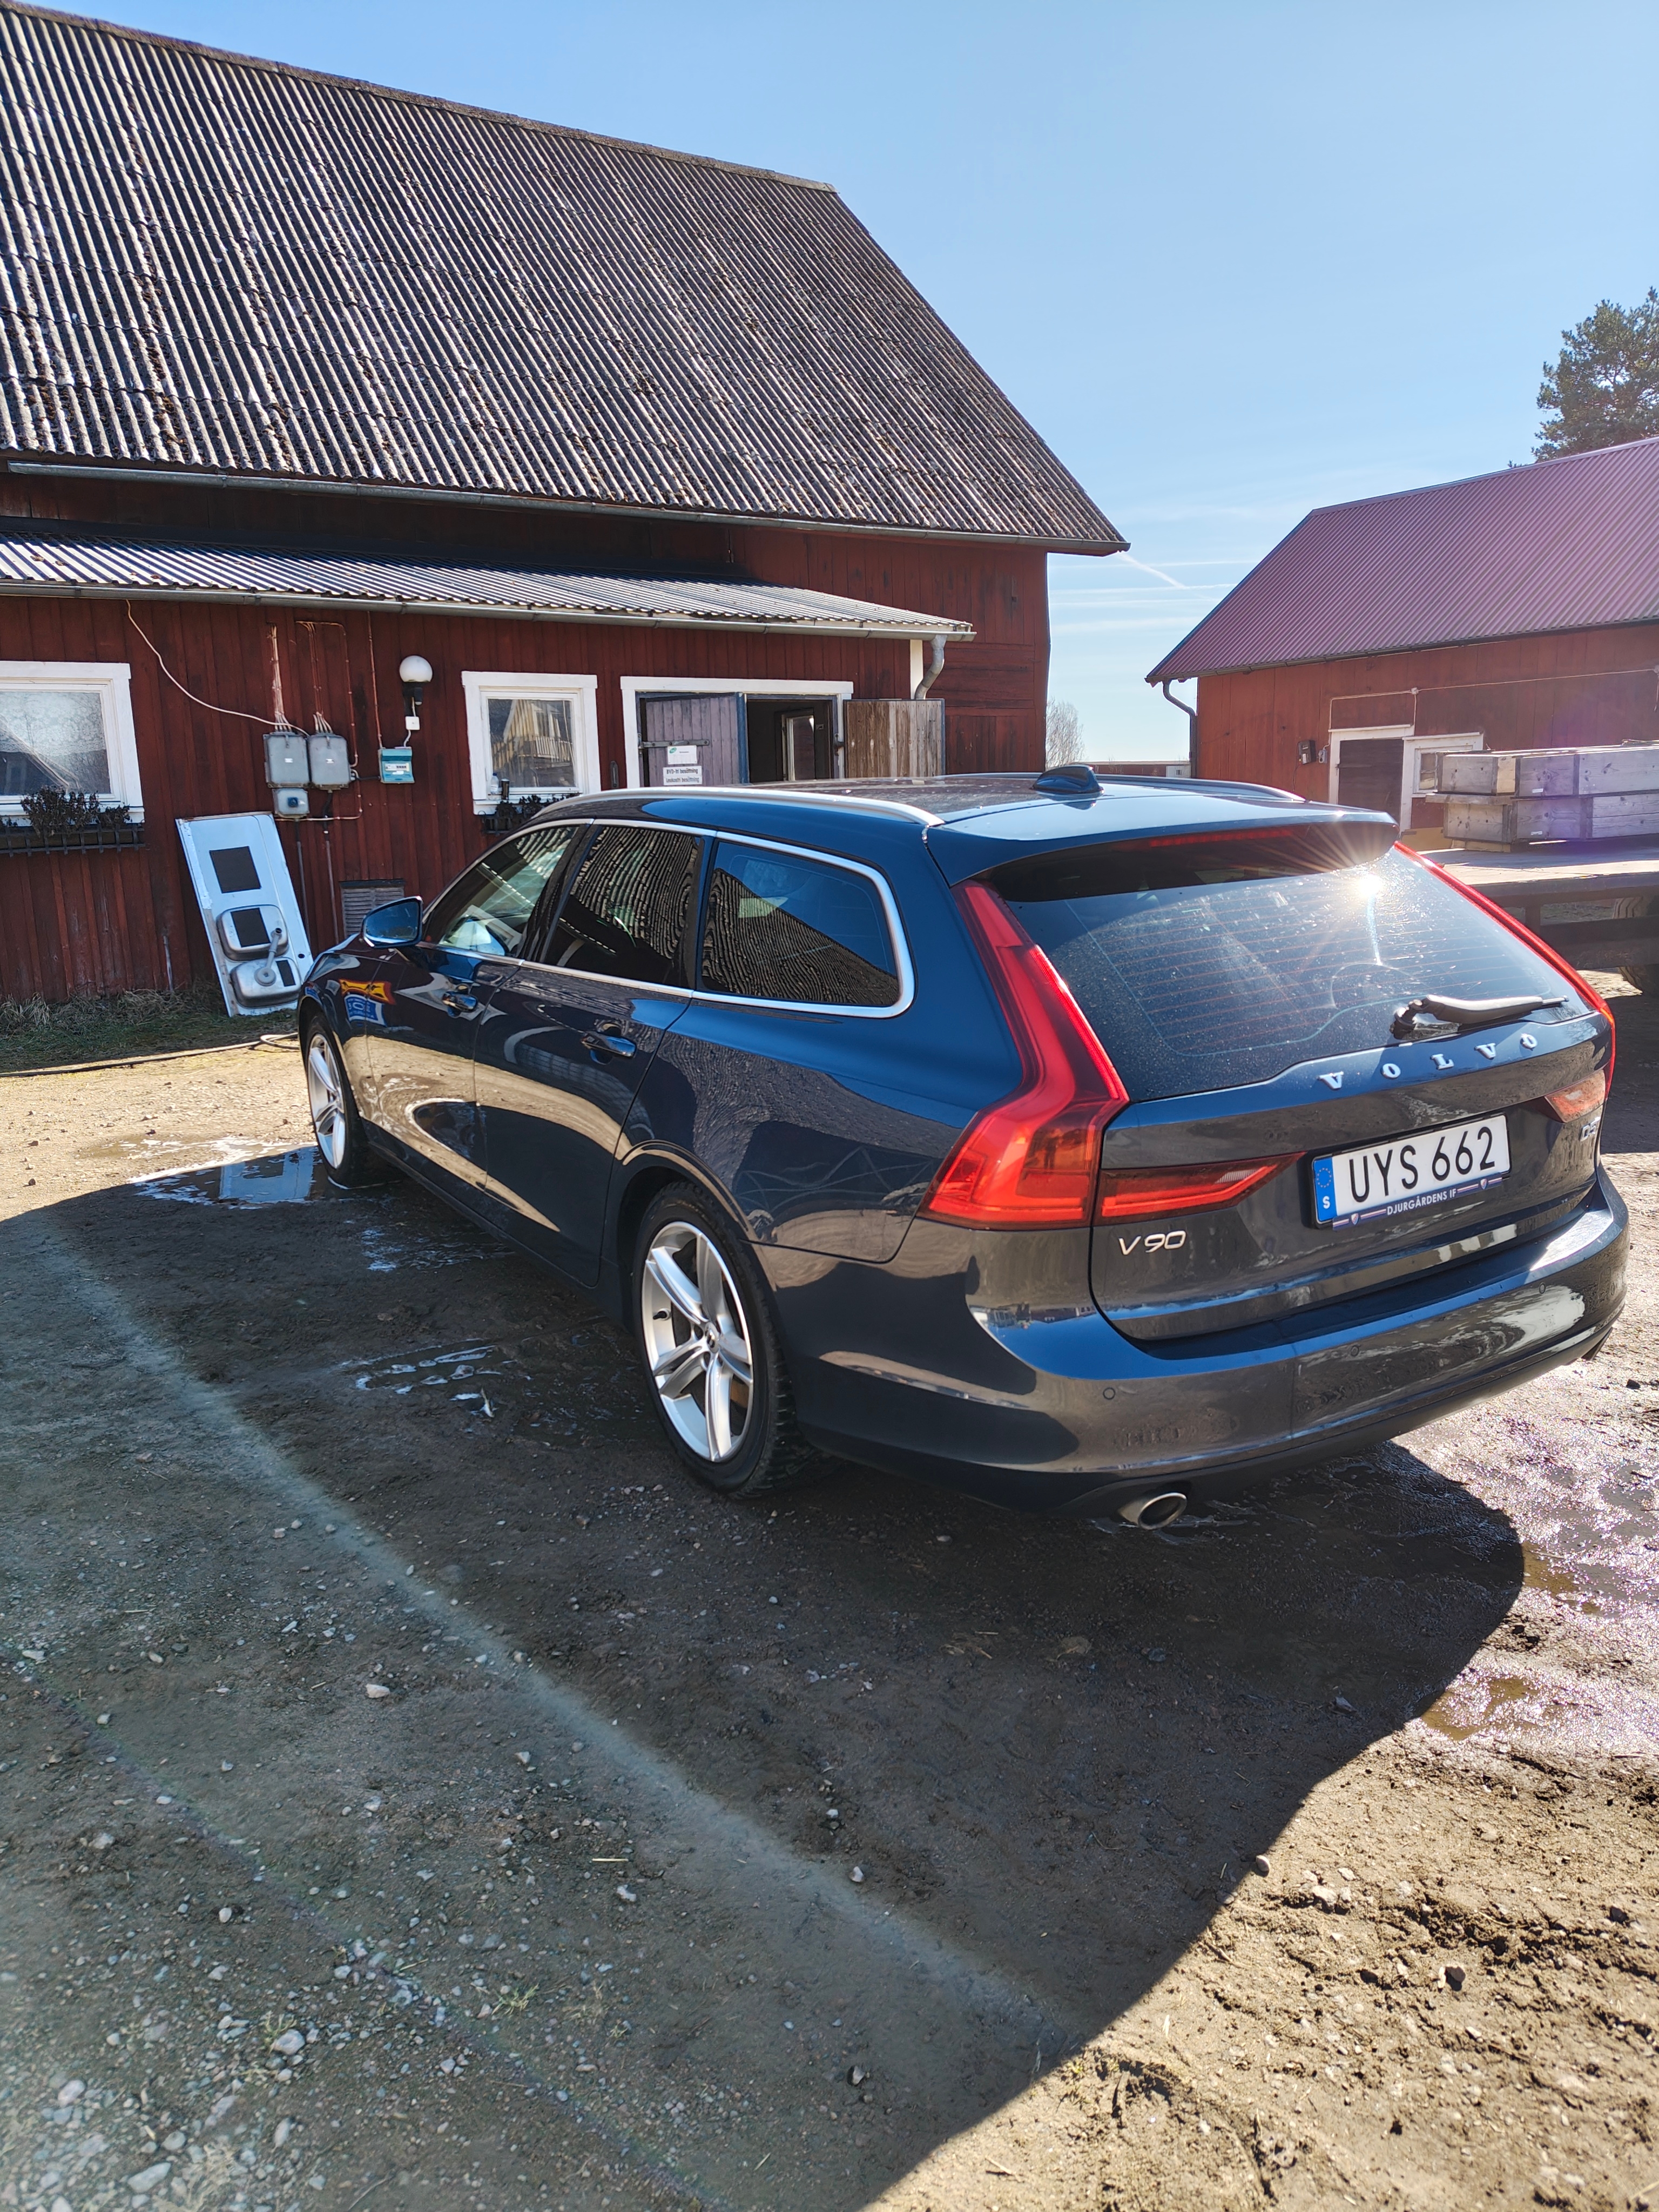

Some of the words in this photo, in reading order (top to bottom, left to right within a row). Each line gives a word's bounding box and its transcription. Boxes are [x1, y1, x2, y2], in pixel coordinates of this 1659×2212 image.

[1319, 1033, 1538, 1090] VOLVO
[1349, 1145, 1418, 1203] UYS
[1432, 1127, 1495, 1181] 662
[1323, 1196, 1330, 1209] S
[1387, 1191, 1448, 1215] DJURGÅRDENS
[1449, 1189, 1457, 1199] IF
[1118, 1230, 1186, 1255] V90
